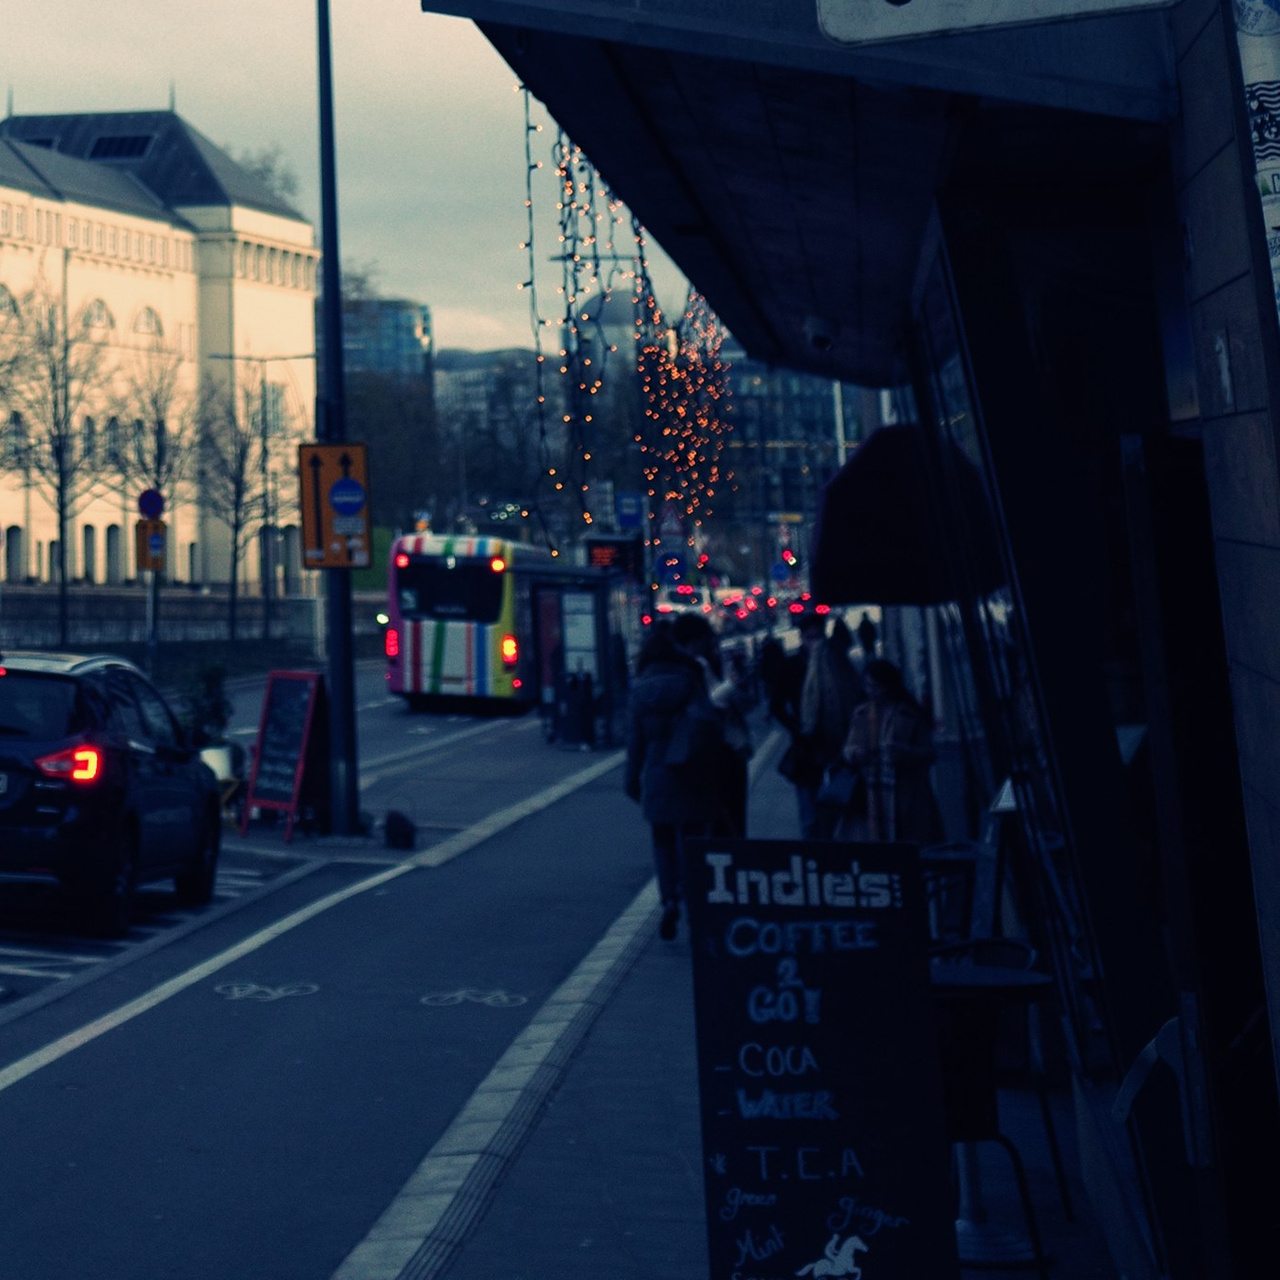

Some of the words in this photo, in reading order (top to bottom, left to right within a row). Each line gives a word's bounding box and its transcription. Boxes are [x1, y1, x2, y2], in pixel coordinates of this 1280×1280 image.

[704, 851, 892, 909] Indie's
[725, 916, 880, 958] COFFEE
[776, 955, 805, 989] 2
[735, 1088, 841, 1122] WATER
